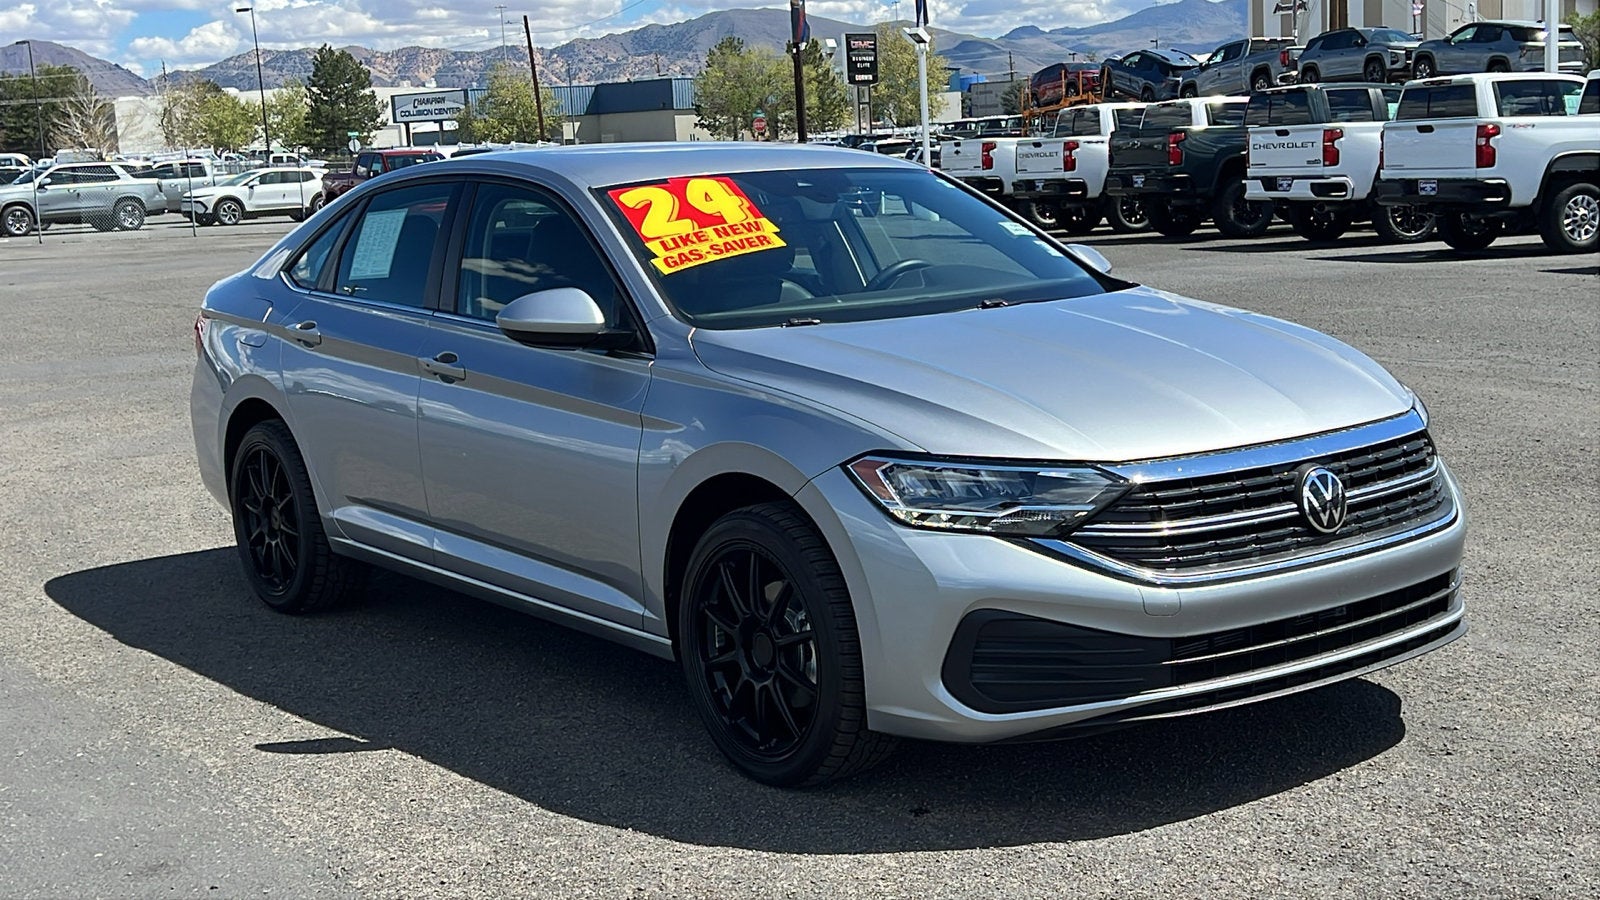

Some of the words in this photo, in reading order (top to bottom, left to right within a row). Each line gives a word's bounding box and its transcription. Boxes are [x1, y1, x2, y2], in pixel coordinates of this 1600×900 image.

[850, 40, 875, 49] GMC
[400, 107, 434, 118] COLLISION
[1252, 141, 1317, 150] CHEVROLET
[1018, 151, 1059, 159] CHEVROLET
[619, 178, 751, 239] 24
[659, 229, 711, 252] LIKE
[713, 220, 763, 240] NEW
[663, 233, 774, 269] GAS-SAVER
